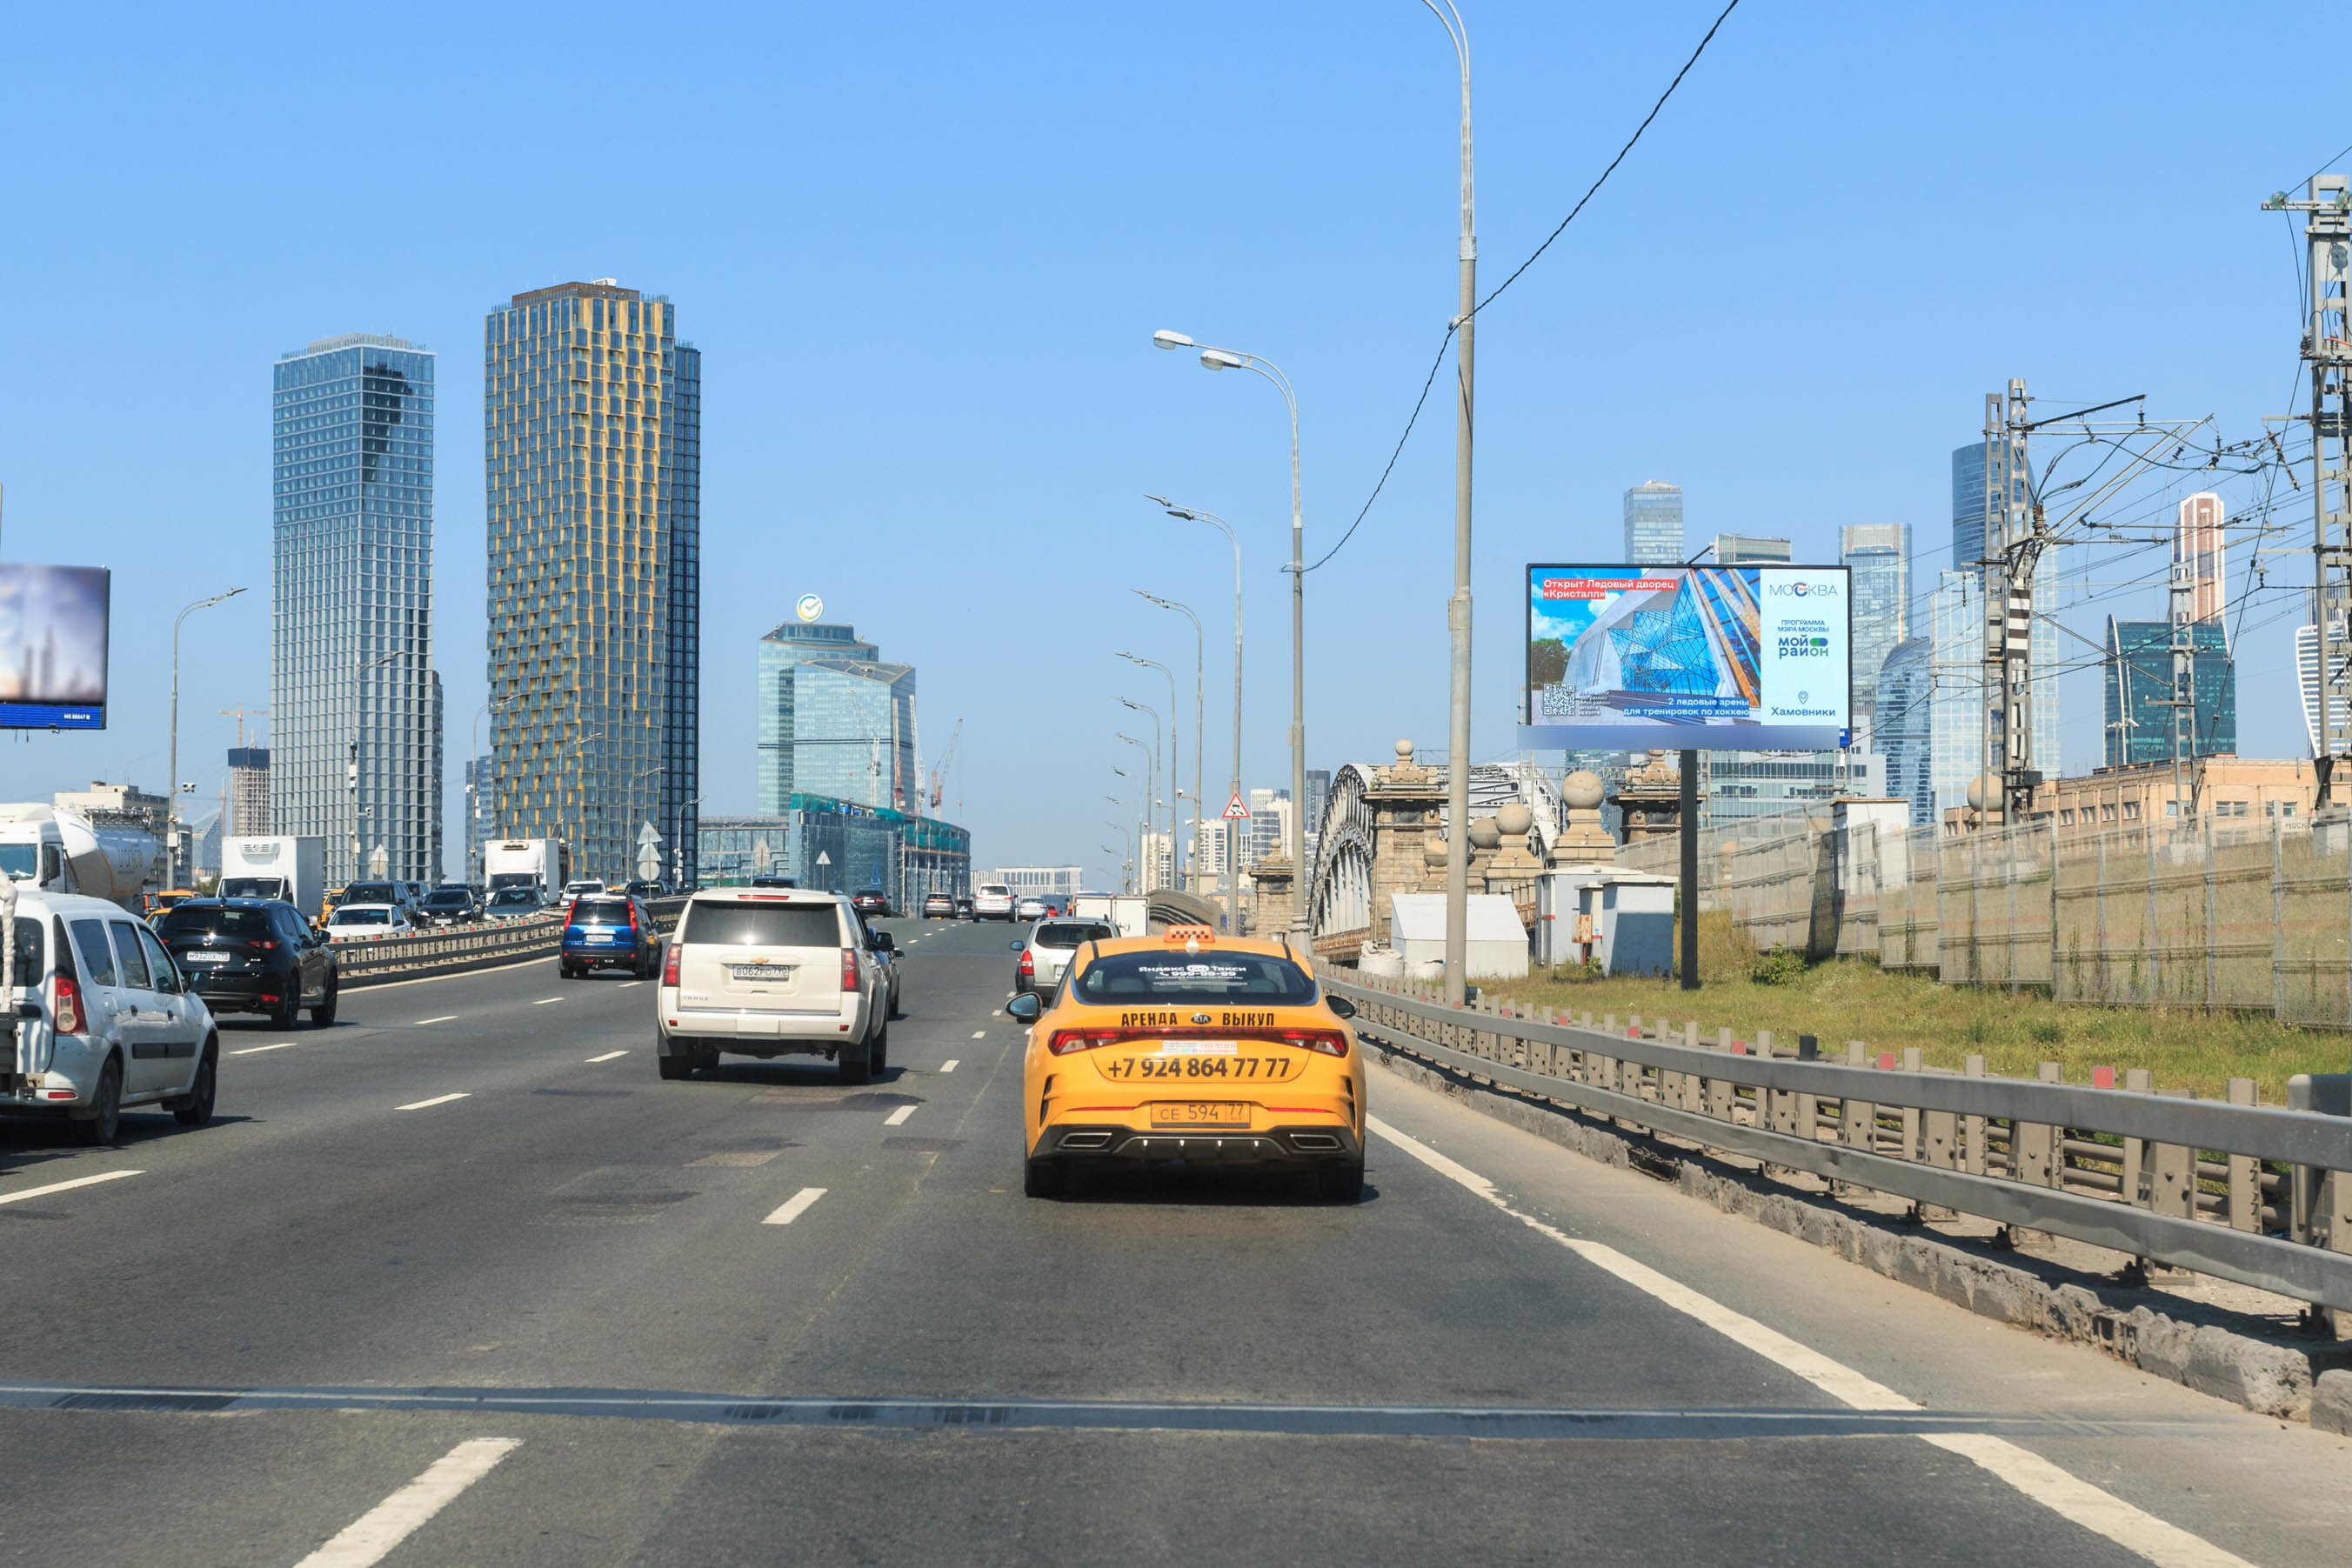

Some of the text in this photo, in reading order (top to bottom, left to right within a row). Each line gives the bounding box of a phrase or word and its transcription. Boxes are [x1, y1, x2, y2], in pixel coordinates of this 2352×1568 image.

[1543, 578, 1674, 590] Открыт Ледовый дворец
[1769, 582, 1838, 597] МОСКВА
[1543, 590, 1606, 599] «Кристалл»
[1778, 634, 1808, 646] мой
[1676, 698, 1717, 707] ледовые
[1719, 698, 1749, 707] арены
[1643, 708, 1699, 717] тренировок
[1771, 707, 1836, 716] Хамовники
[1121, 1012, 1178, 1026] АРЕНДА
[1222, 1012, 1275, 1026] ВЫКУП
[1108, 1058, 1291, 1078] +7 924 864 77 77
[1160, 1103, 1244, 1120] СЕ 594 77
